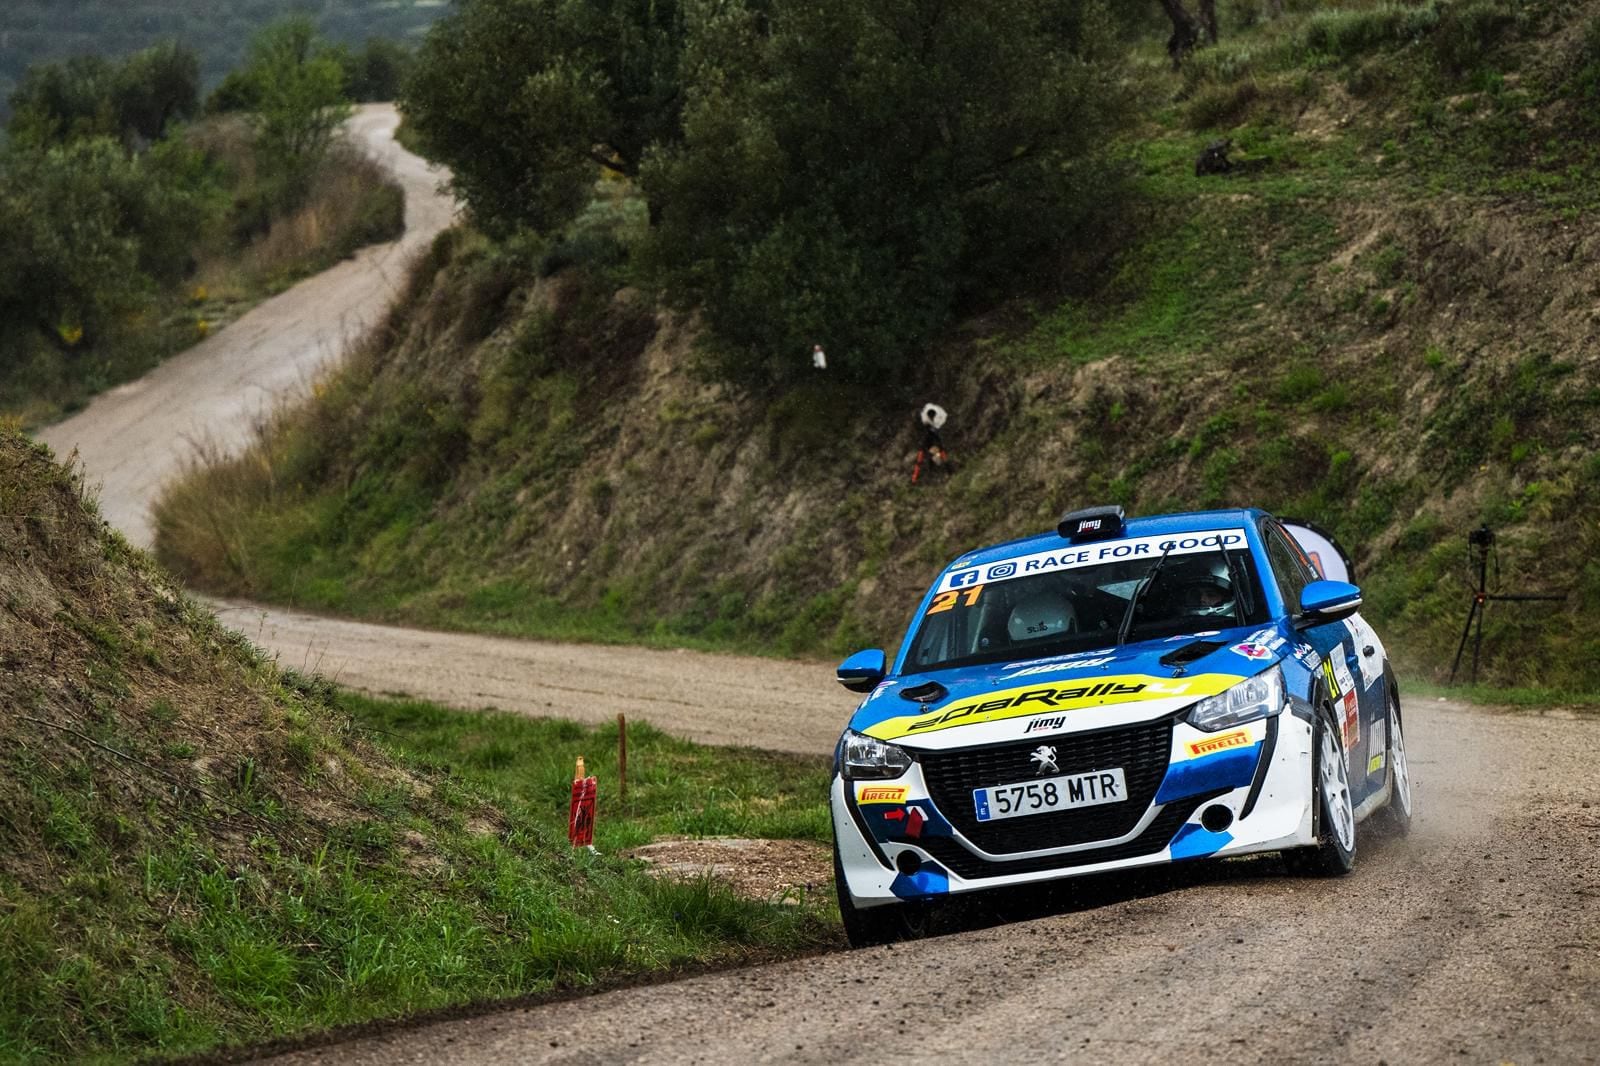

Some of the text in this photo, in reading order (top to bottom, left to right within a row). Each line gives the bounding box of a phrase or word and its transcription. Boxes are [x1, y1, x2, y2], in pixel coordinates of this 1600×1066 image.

[1077, 519, 1102, 533] jimy
[1025, 550, 1091, 572] RACE
[1098, 543, 1150, 560] FOR
[1158, 535, 1242, 552] GOOD
[926, 584, 985, 616] 21
[1023, 716, 1067, 734] jimy
[1190, 732, 1249, 755] PIRELLI
[861, 787, 906, 801] PIRELLI
[994, 772, 1117, 815] 5758 MTR
